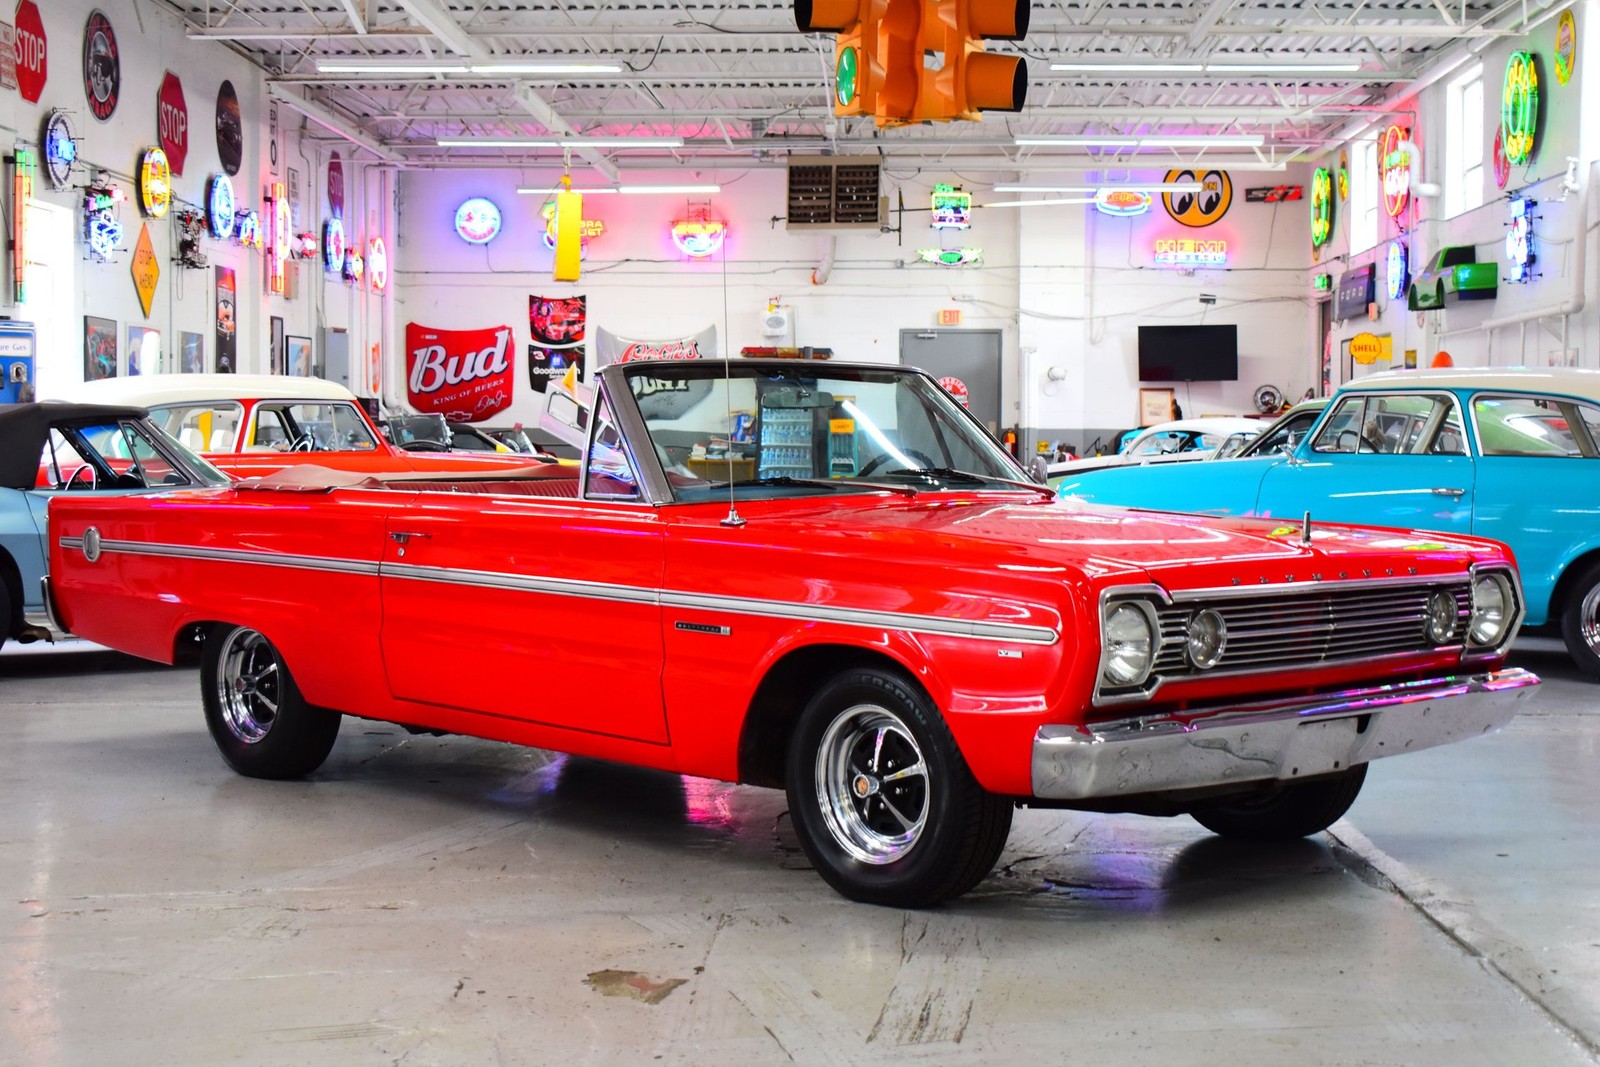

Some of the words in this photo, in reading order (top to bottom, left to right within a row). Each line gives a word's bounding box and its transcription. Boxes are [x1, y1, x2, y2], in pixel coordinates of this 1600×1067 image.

[15, 27, 45, 73] STOP
[161, 101, 186, 146] STOP
[330, 170, 344, 198] STOP
[1156, 240, 1227, 253] HEMI
[1341, 285, 1364, 300] FORD
[943, 310, 960, 324] EXIT
[12, 343, 27, 351] Gas
[1353, 344, 1377, 353] SHELL
[409, 329, 509, 394] Bud
[433, 395, 457, 405] KING
[475, 378, 505, 393] BEERS
[1232, 567, 1418, 584] PLYMOUTH
